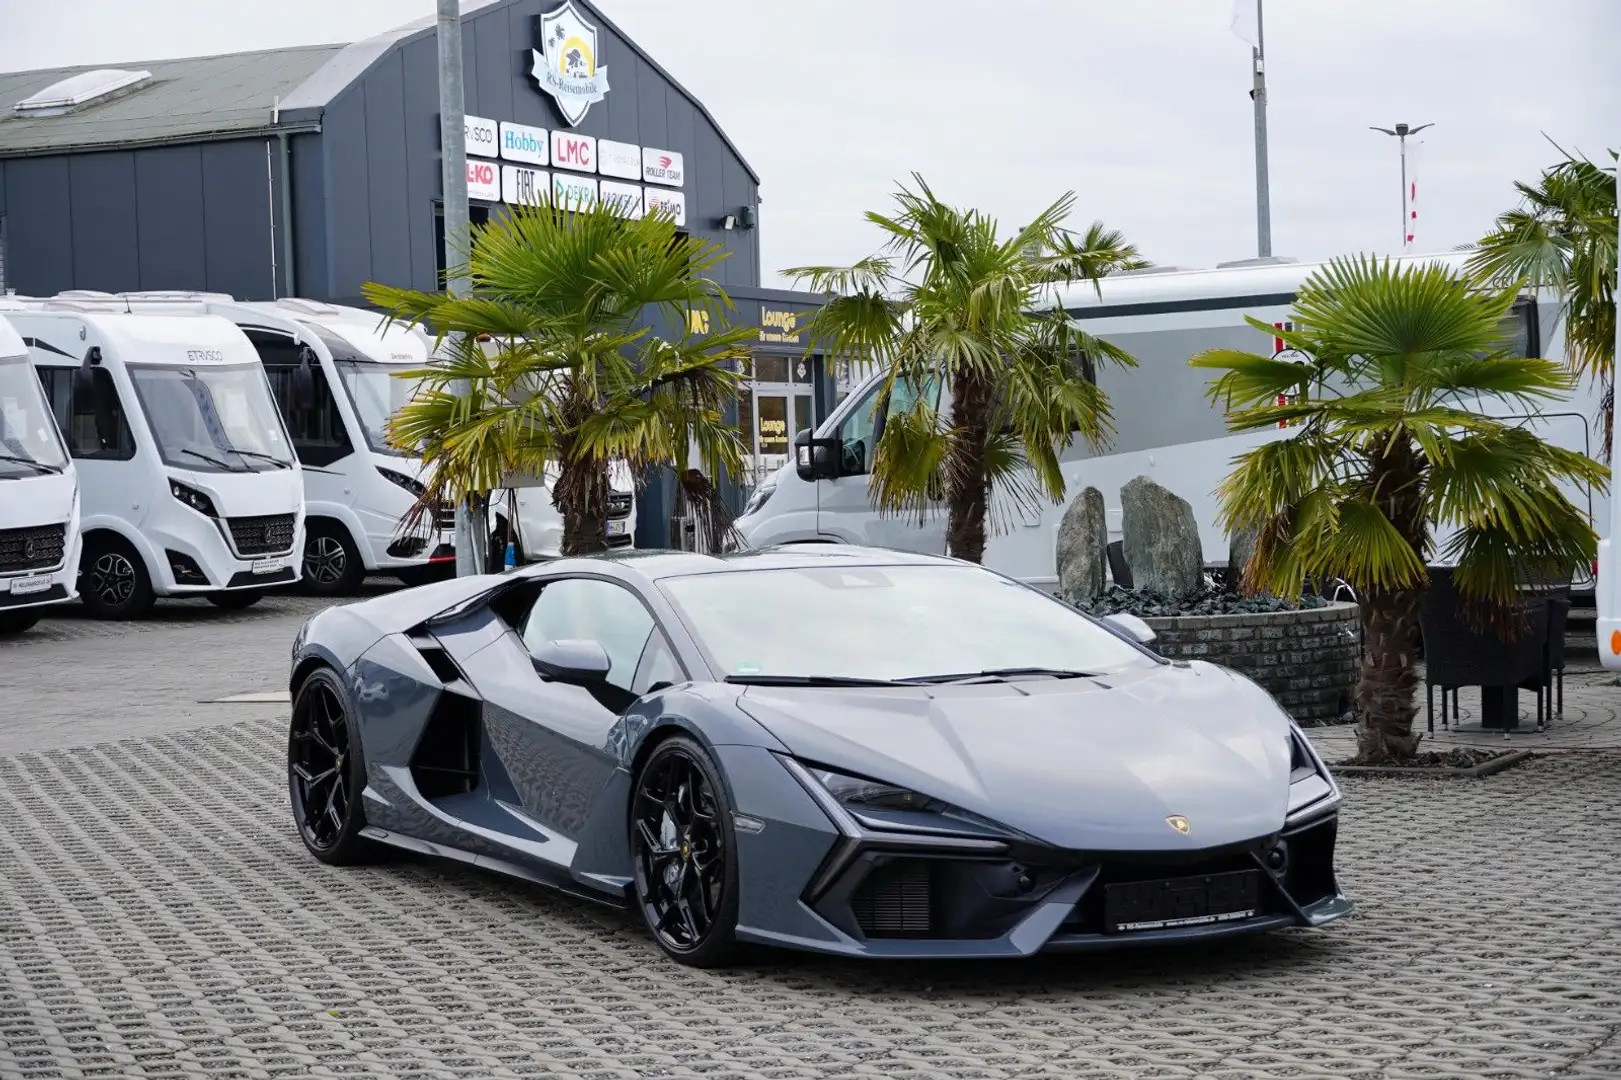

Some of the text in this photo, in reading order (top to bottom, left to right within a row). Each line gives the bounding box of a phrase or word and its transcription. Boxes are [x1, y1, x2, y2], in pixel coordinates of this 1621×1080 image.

[504, 130, 544, 158] Hobby
[557, 137, 589, 166] LMC
[465, 163, 493, 185] L-KO
[516, 169, 535, 200] FIAT
[645, 166, 681, 180] ROLLER TEAM
[568, 184, 597, 203] DEKRA
[761, 306, 796, 332] Lounge
[760, 417, 785, 435] Lounge
